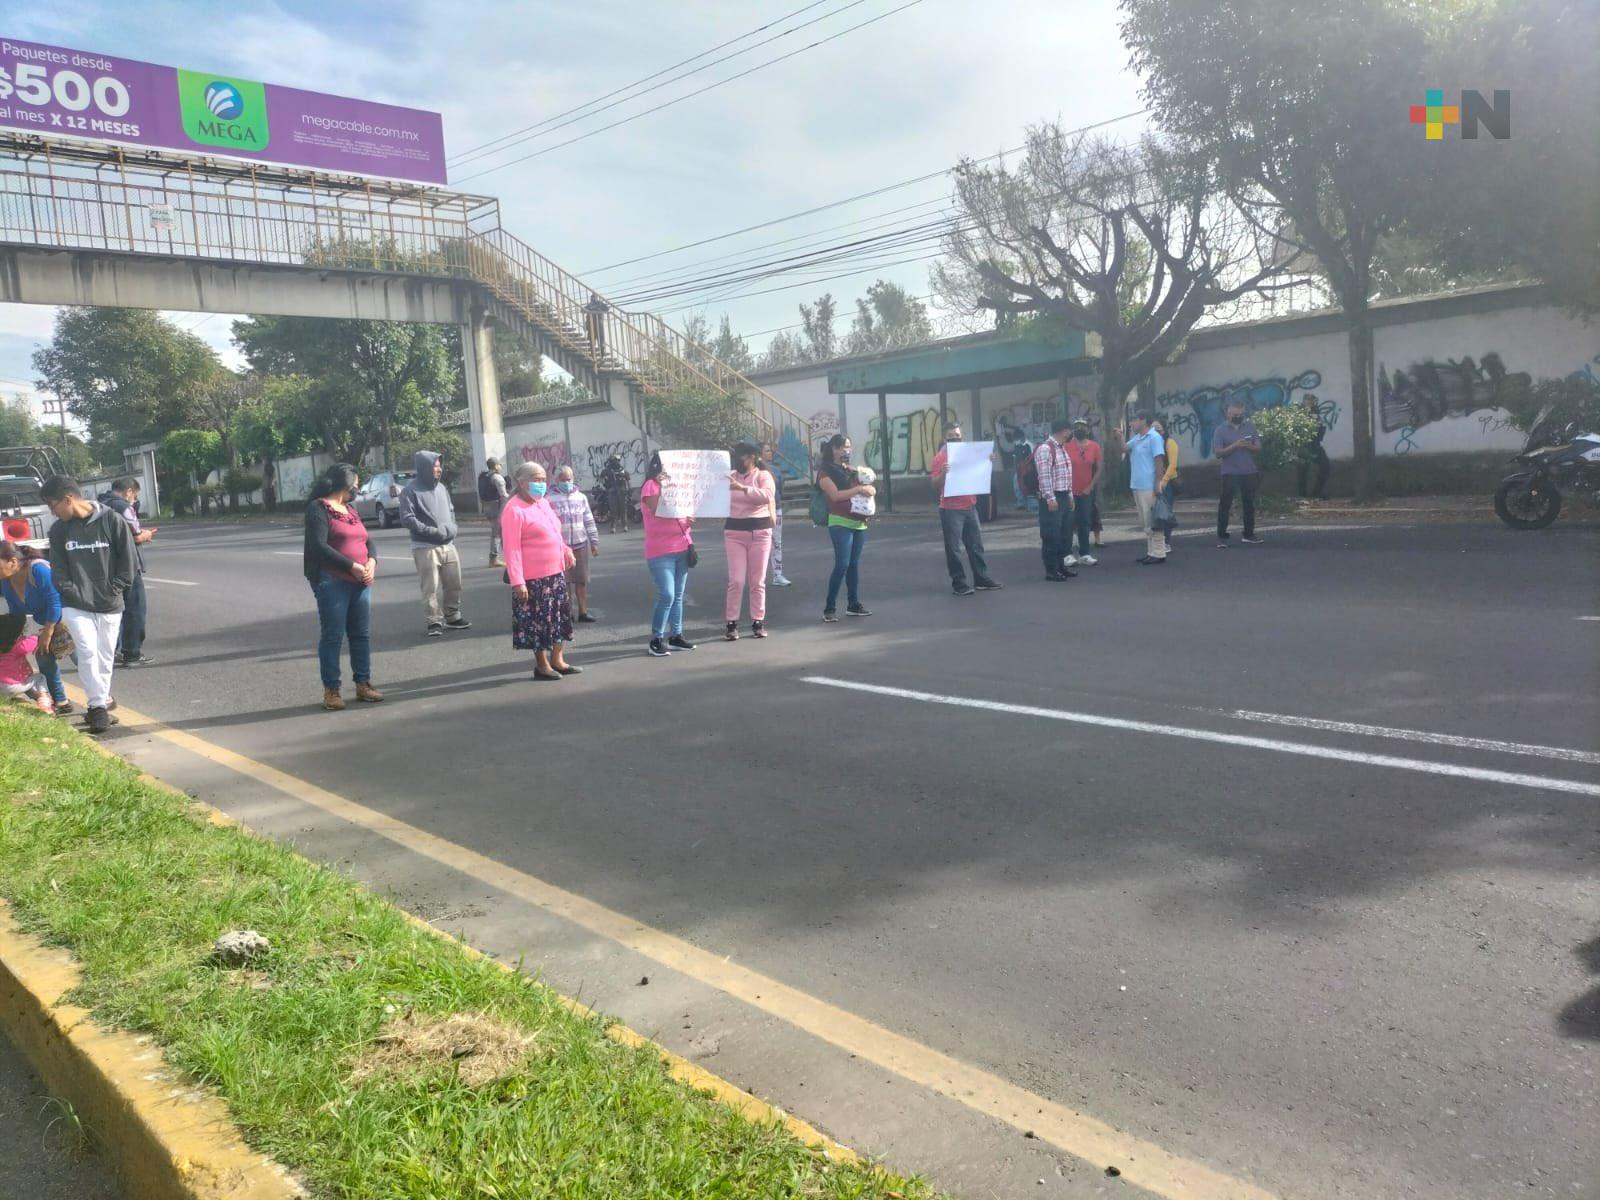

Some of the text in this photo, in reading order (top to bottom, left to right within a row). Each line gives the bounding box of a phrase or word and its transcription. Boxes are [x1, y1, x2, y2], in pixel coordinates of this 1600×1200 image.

[2, 42, 112, 71] Paquetes desde
[0, 106, 140, 137] al mes X 12 MESES
[198, 120, 256, 143] MEGA
[302, 114, 419, 141] megacable.com.mx
